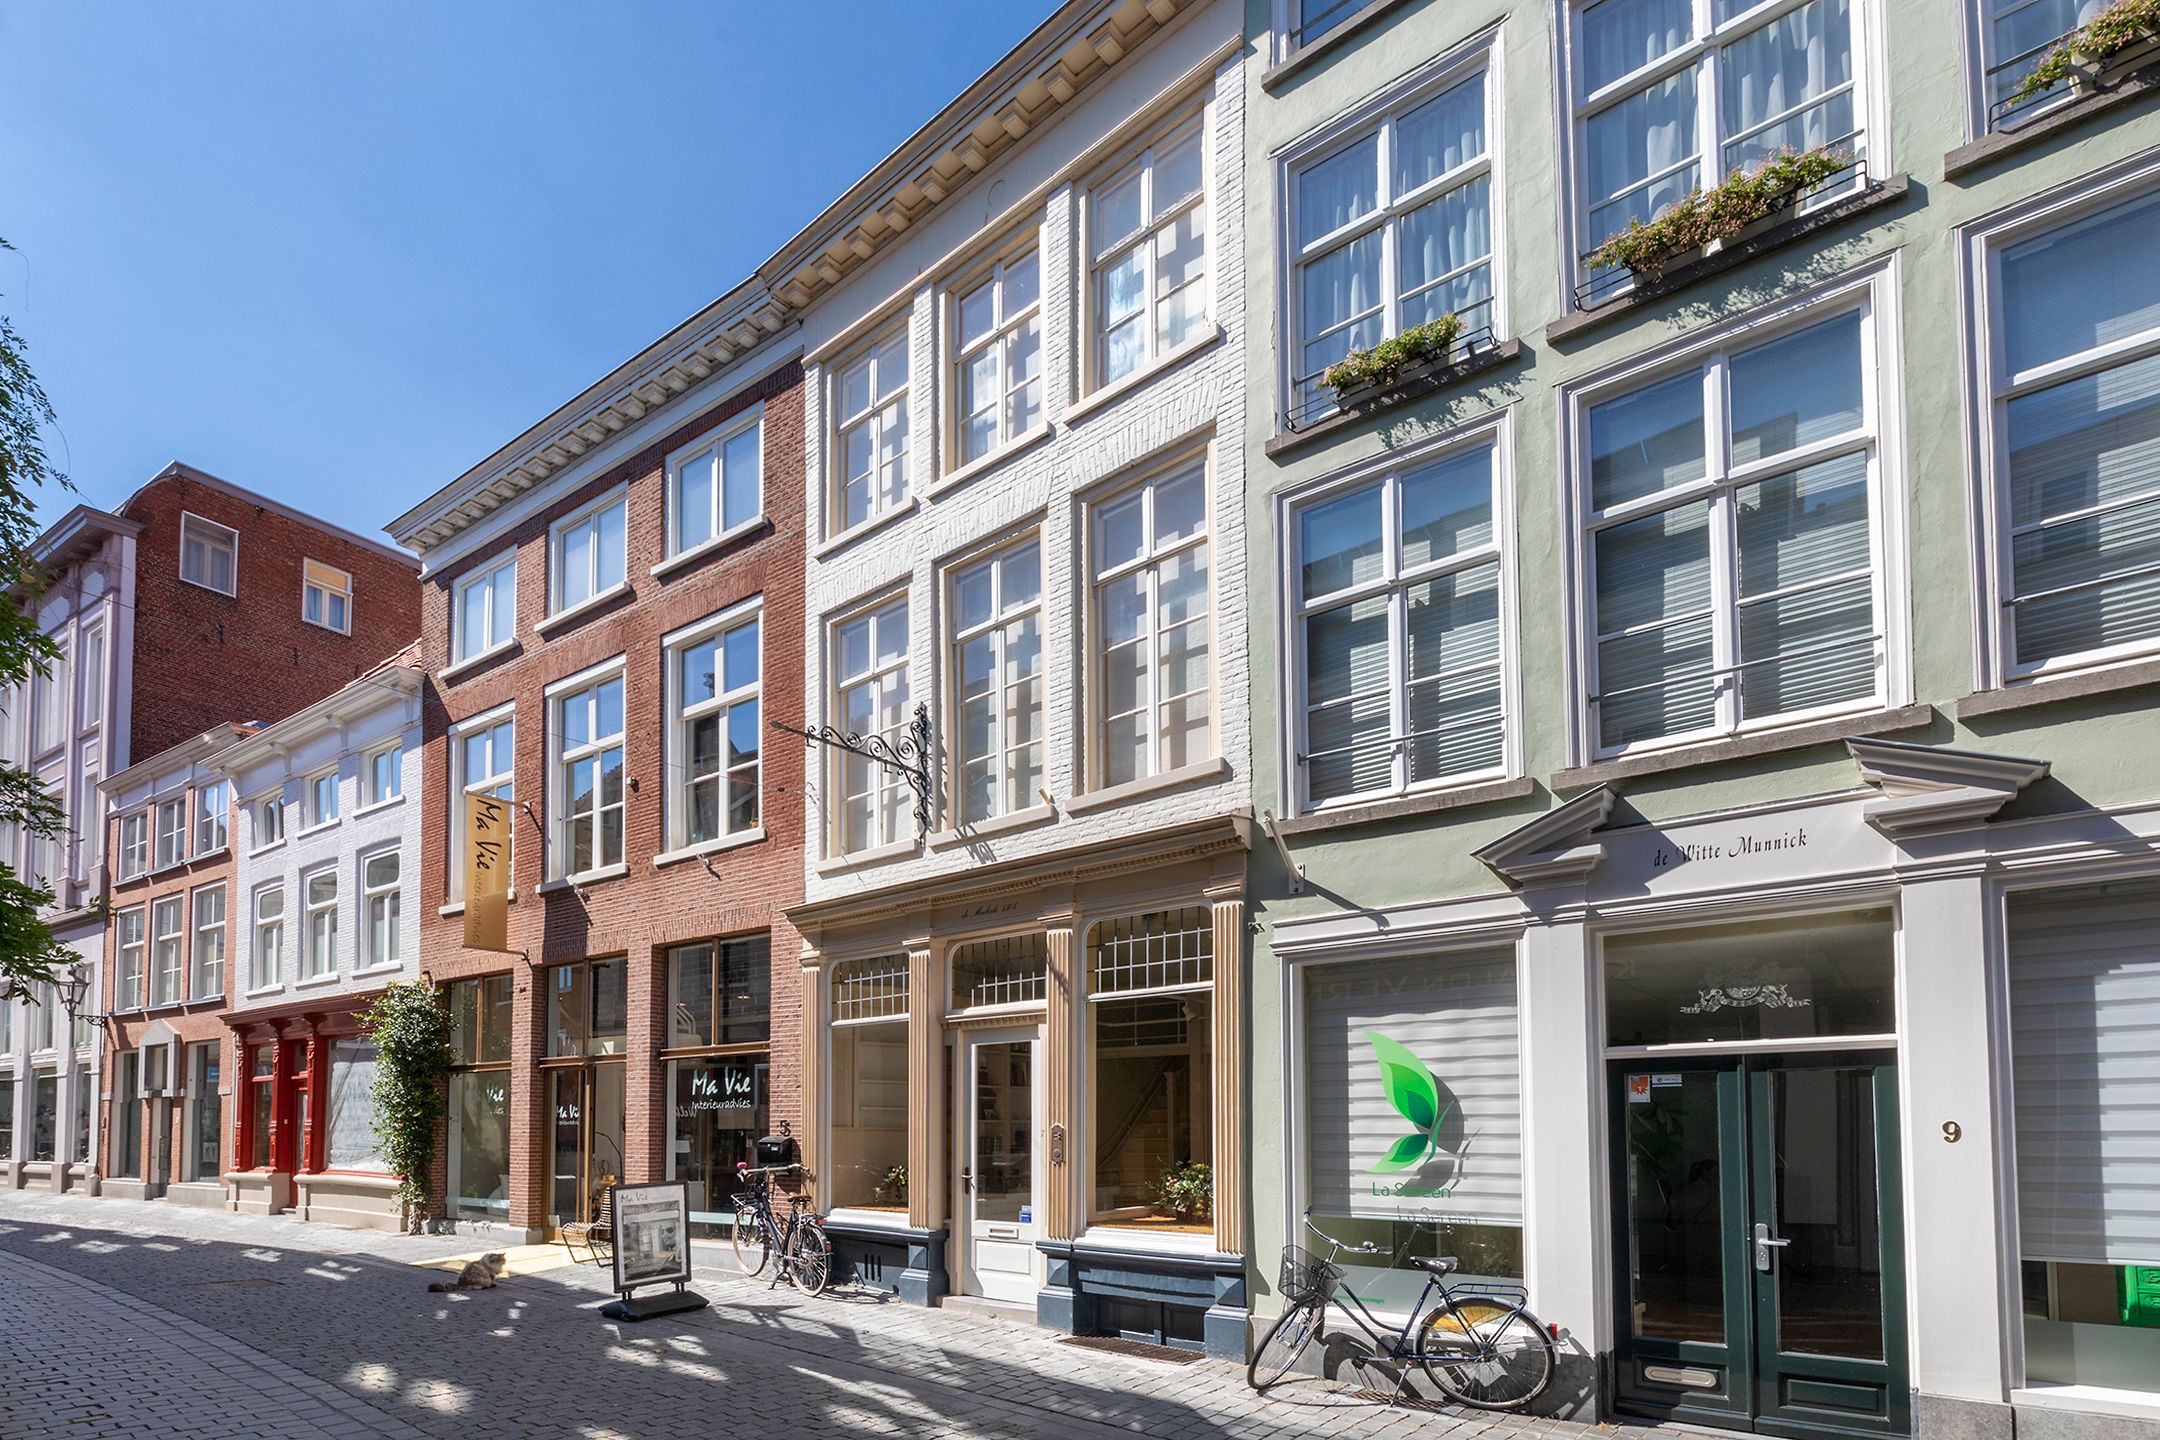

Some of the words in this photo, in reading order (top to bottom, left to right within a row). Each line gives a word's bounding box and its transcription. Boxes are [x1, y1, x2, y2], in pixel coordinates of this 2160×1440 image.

[476, 799, 502, 831] Ma
[475, 840, 502, 870] Vie
[1654, 849, 1668, 867] de
[1676, 844, 1721, 863] Witte
[1728, 828, 1807, 858] Munnick
[692, 1069, 718, 1095] Ma
[725, 1066, 751, 1095] Vie
[569, 1104, 580, 1119] Vi
[1942, 1120, 1962, 1143] 9
[1372, 1182, 1390, 1197] La
